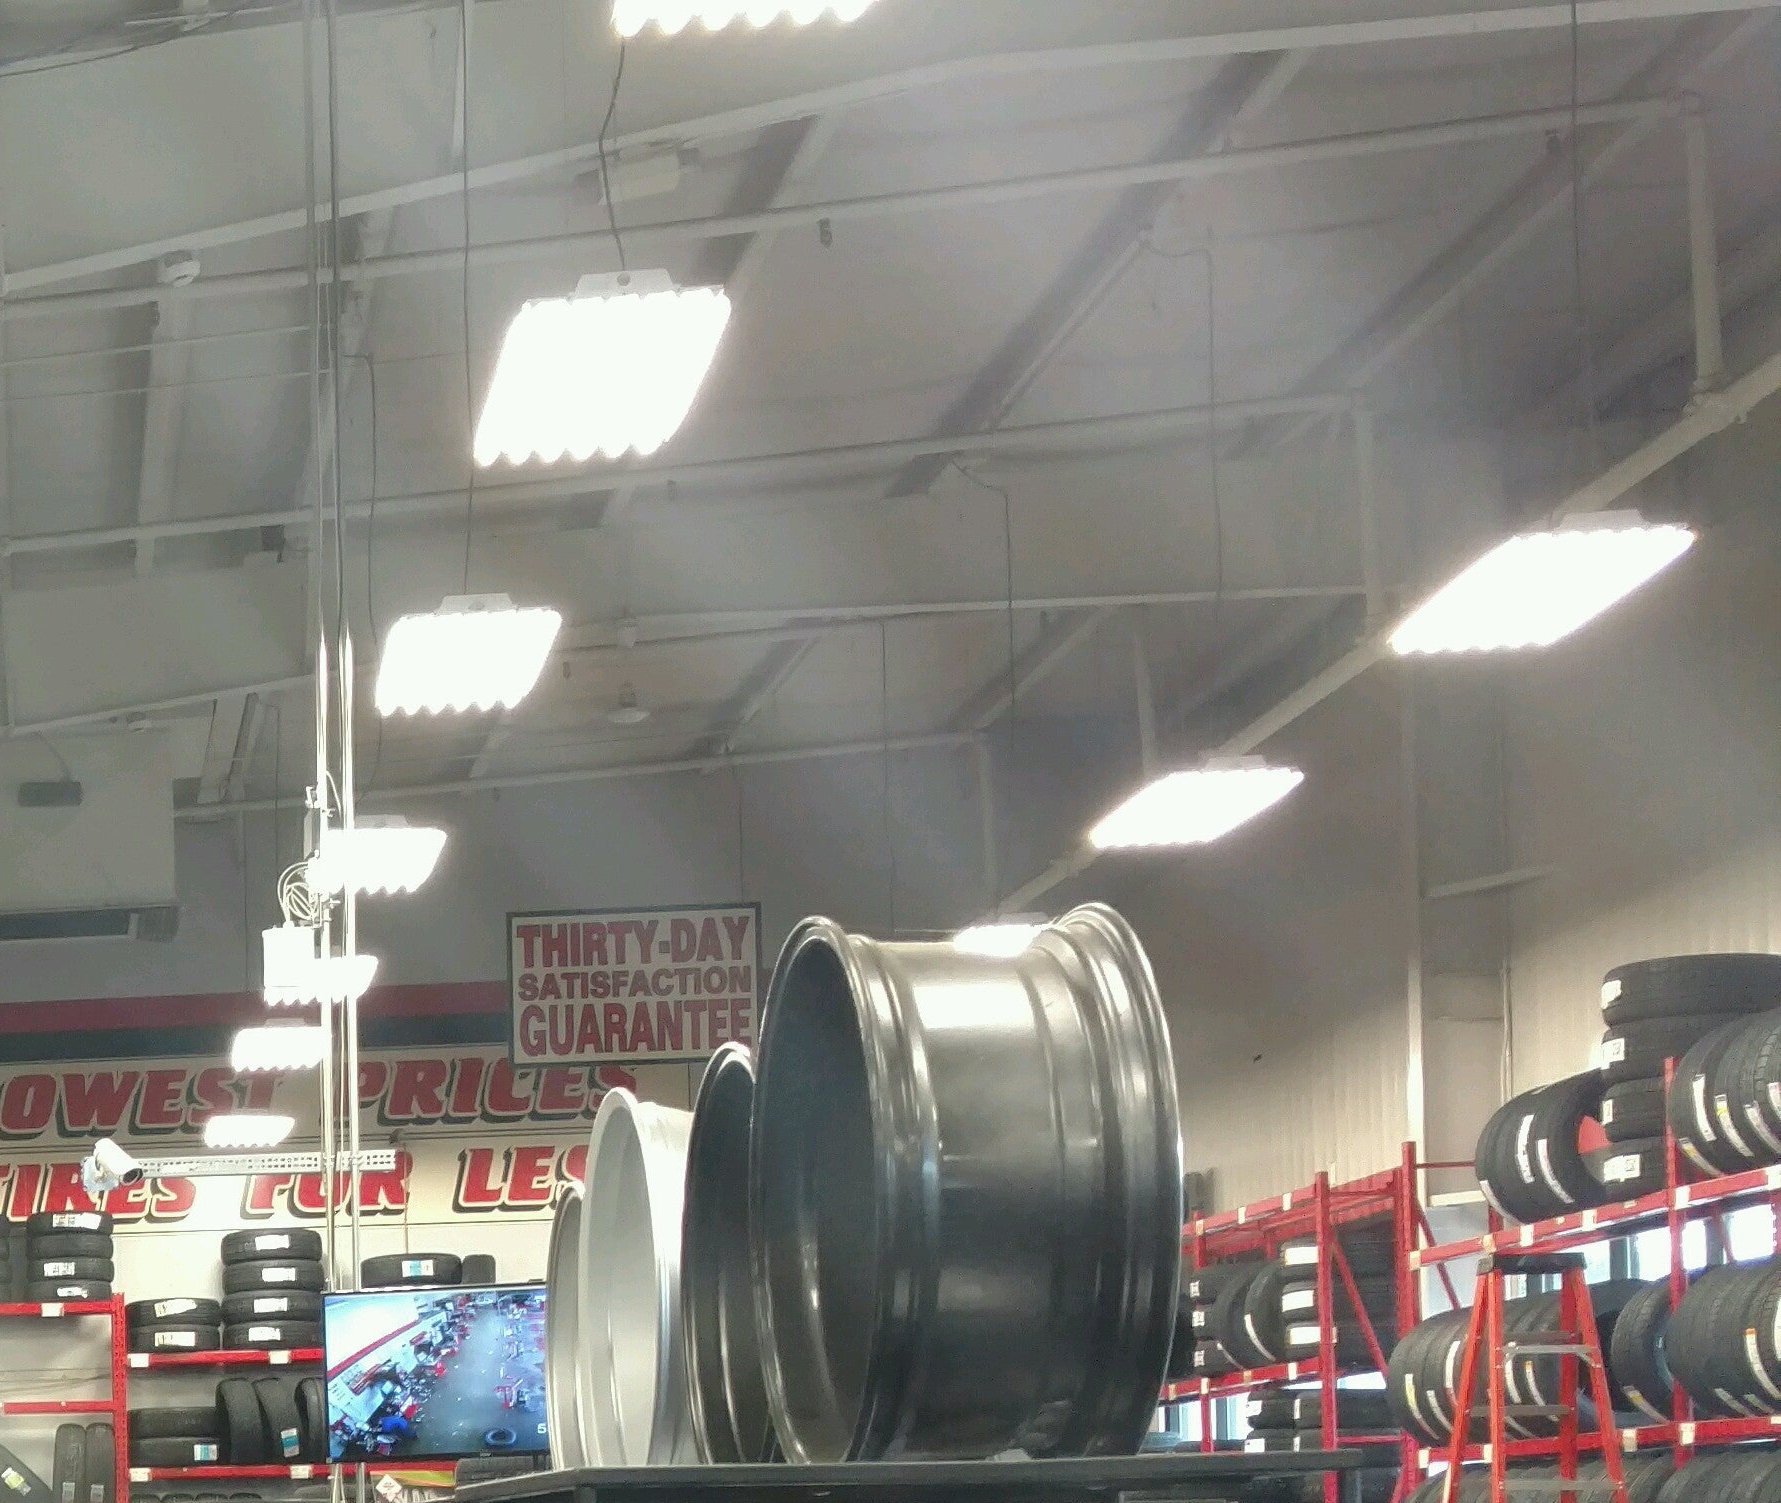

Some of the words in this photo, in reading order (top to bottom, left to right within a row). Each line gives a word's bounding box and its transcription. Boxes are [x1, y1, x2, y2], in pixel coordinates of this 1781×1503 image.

[517, 917, 750, 968] THIRTY-DAY
[518, 966, 752, 1001] SATISFACTION
[520, 998, 752, 1056] GUARANTEE
